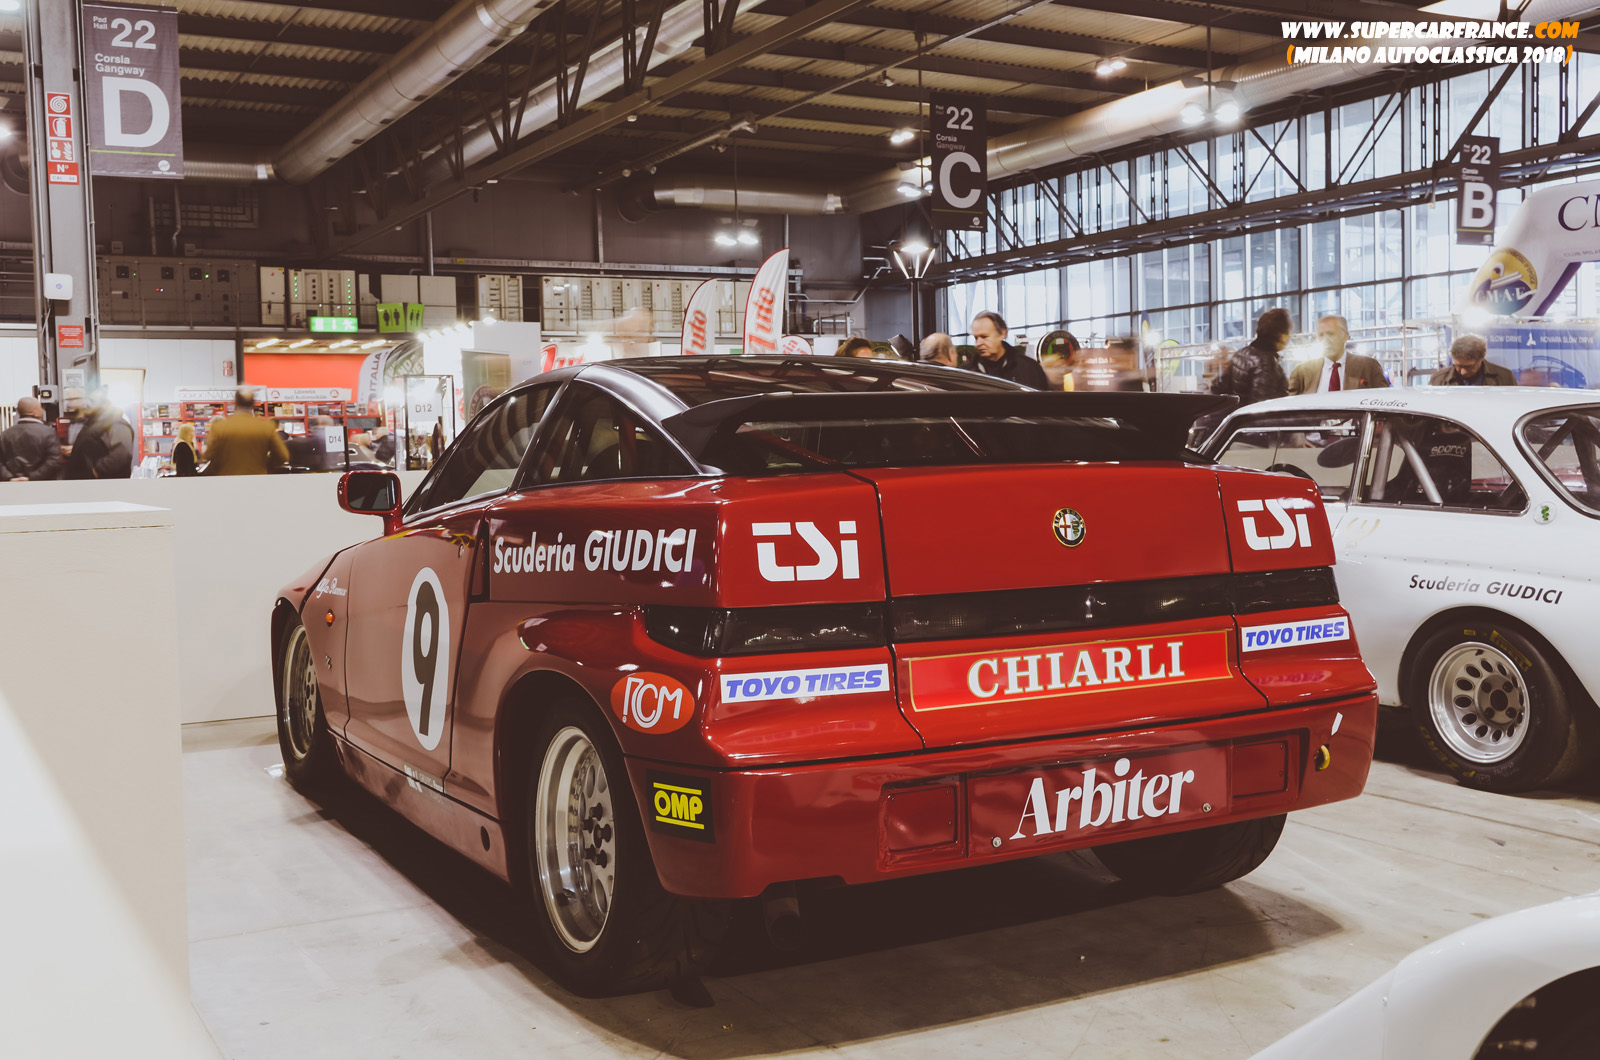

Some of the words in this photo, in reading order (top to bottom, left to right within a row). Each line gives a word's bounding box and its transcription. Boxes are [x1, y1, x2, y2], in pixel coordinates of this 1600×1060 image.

[111, 18, 156, 50] 22
[95, 53, 131, 64] Corsia
[95, 63, 145, 77] Gangway
[102, 76, 170, 148] D
[946, 106, 974, 131] 22
[935, 133, 958, 142] Corsia
[935, 141, 966, 152] Gangway
[1470, 144, 1492, 165] 22
[939, 151, 982, 209] C
[1461, 182, 1494, 228] B
[1505, 335, 1522, 343] DRIVE
[1540, 335, 1562, 343] NOVARA
[1578, 336, 1595, 344] DRIVE
[415, 403, 432, 413] D12
[328, 435, 342, 444] D14
[1430, 445, 1467, 456] sparco
[494, 532, 575, 574] Scuderia
[583, 528, 697, 573] GIUDICI
[1409, 574, 1480, 593] Scuderia
[1486, 581, 1563, 604] GIUDICI
[1246, 630, 1293, 649] TOYO
[1295, 621, 1345, 643] TIRES
[413, 581, 439, 736] 9
[966, 641, 1186, 698] CHIARLI
[725, 677, 802, 699] TOYO
[804, 669, 883, 692] TIRES
[654, 790, 703, 822] OMP
[1009, 757, 1194, 840] Arbiter
